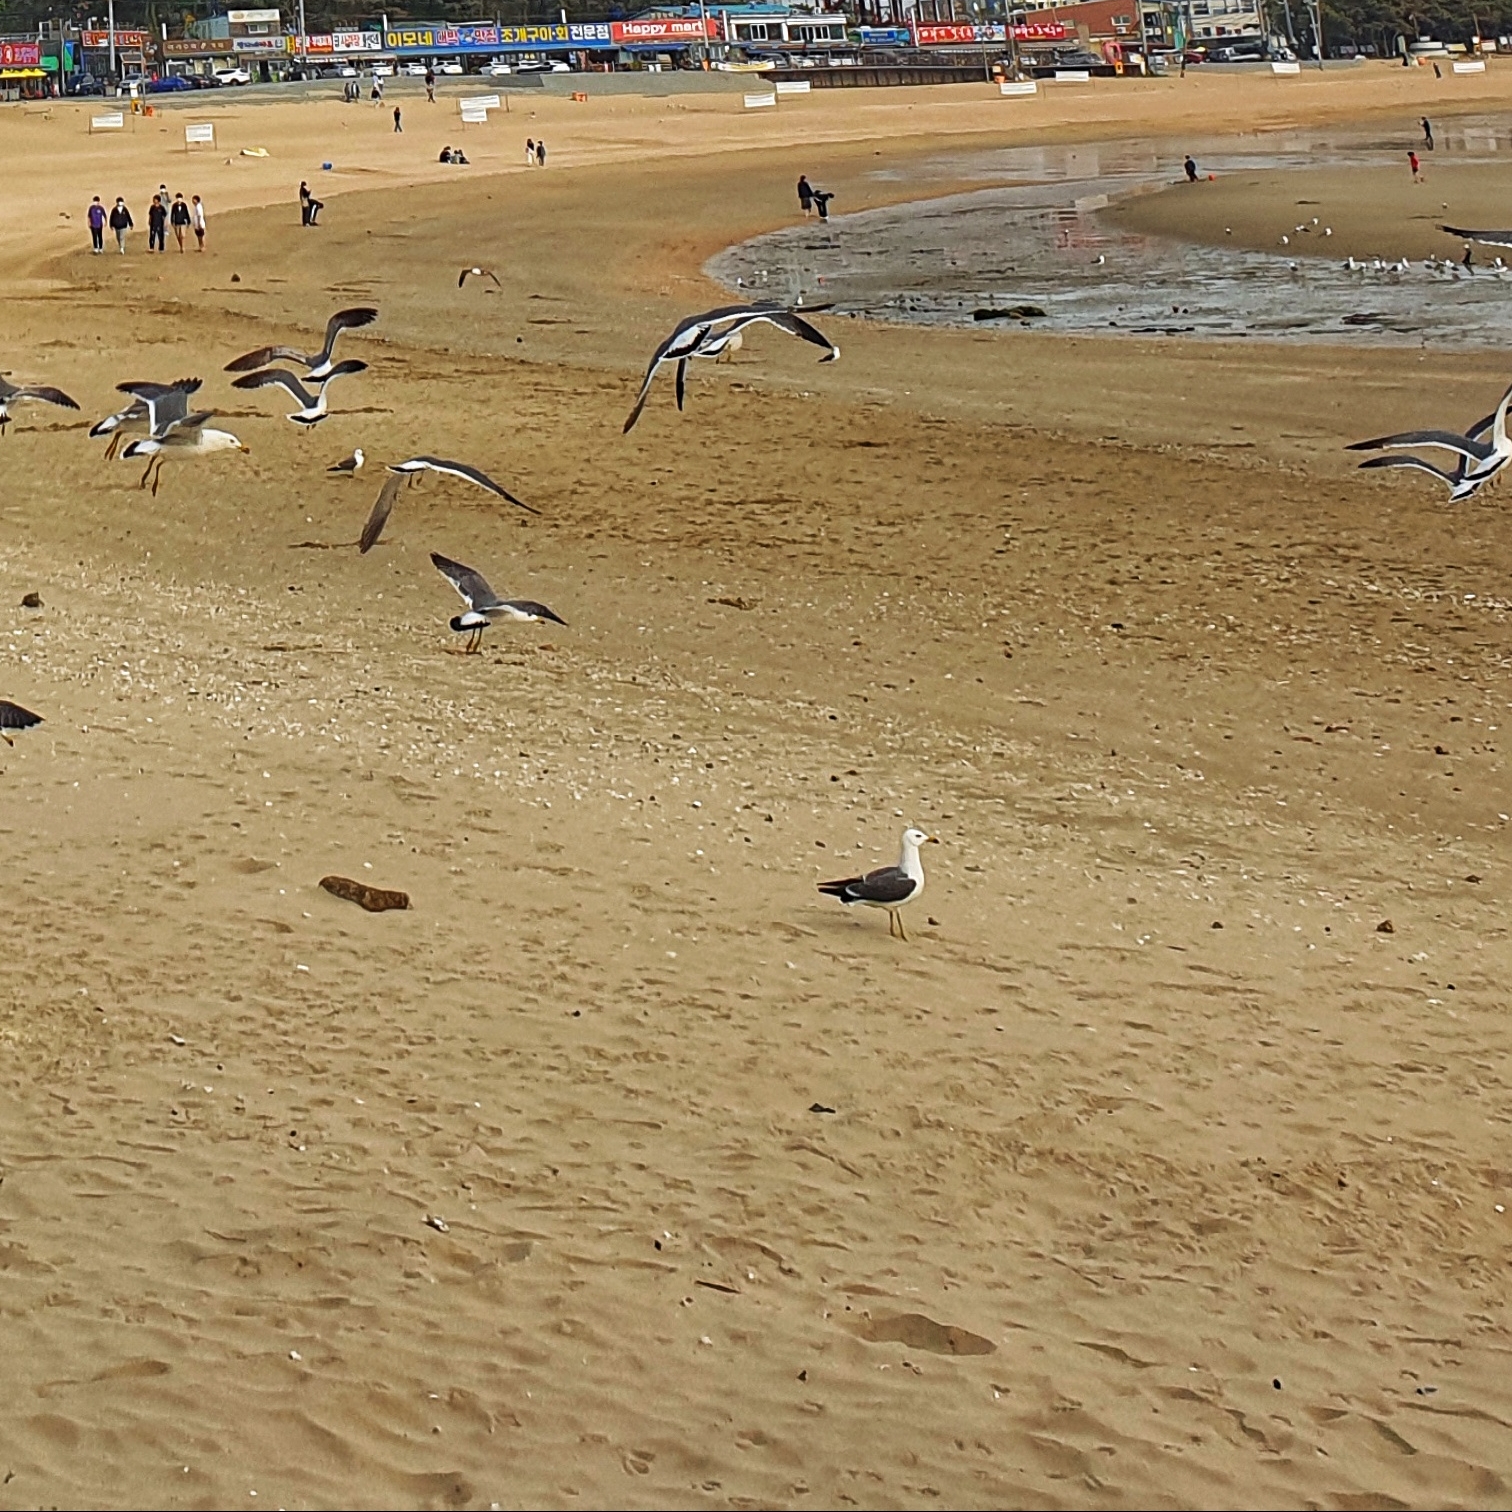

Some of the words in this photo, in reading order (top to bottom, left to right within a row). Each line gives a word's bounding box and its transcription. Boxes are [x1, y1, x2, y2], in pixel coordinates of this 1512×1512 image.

[386, 30, 434, 48] 이모네
[570, 24, 611, 41] 전문점
[622, 20, 668, 39] Happy
[671, 20, 704, 34] mart
